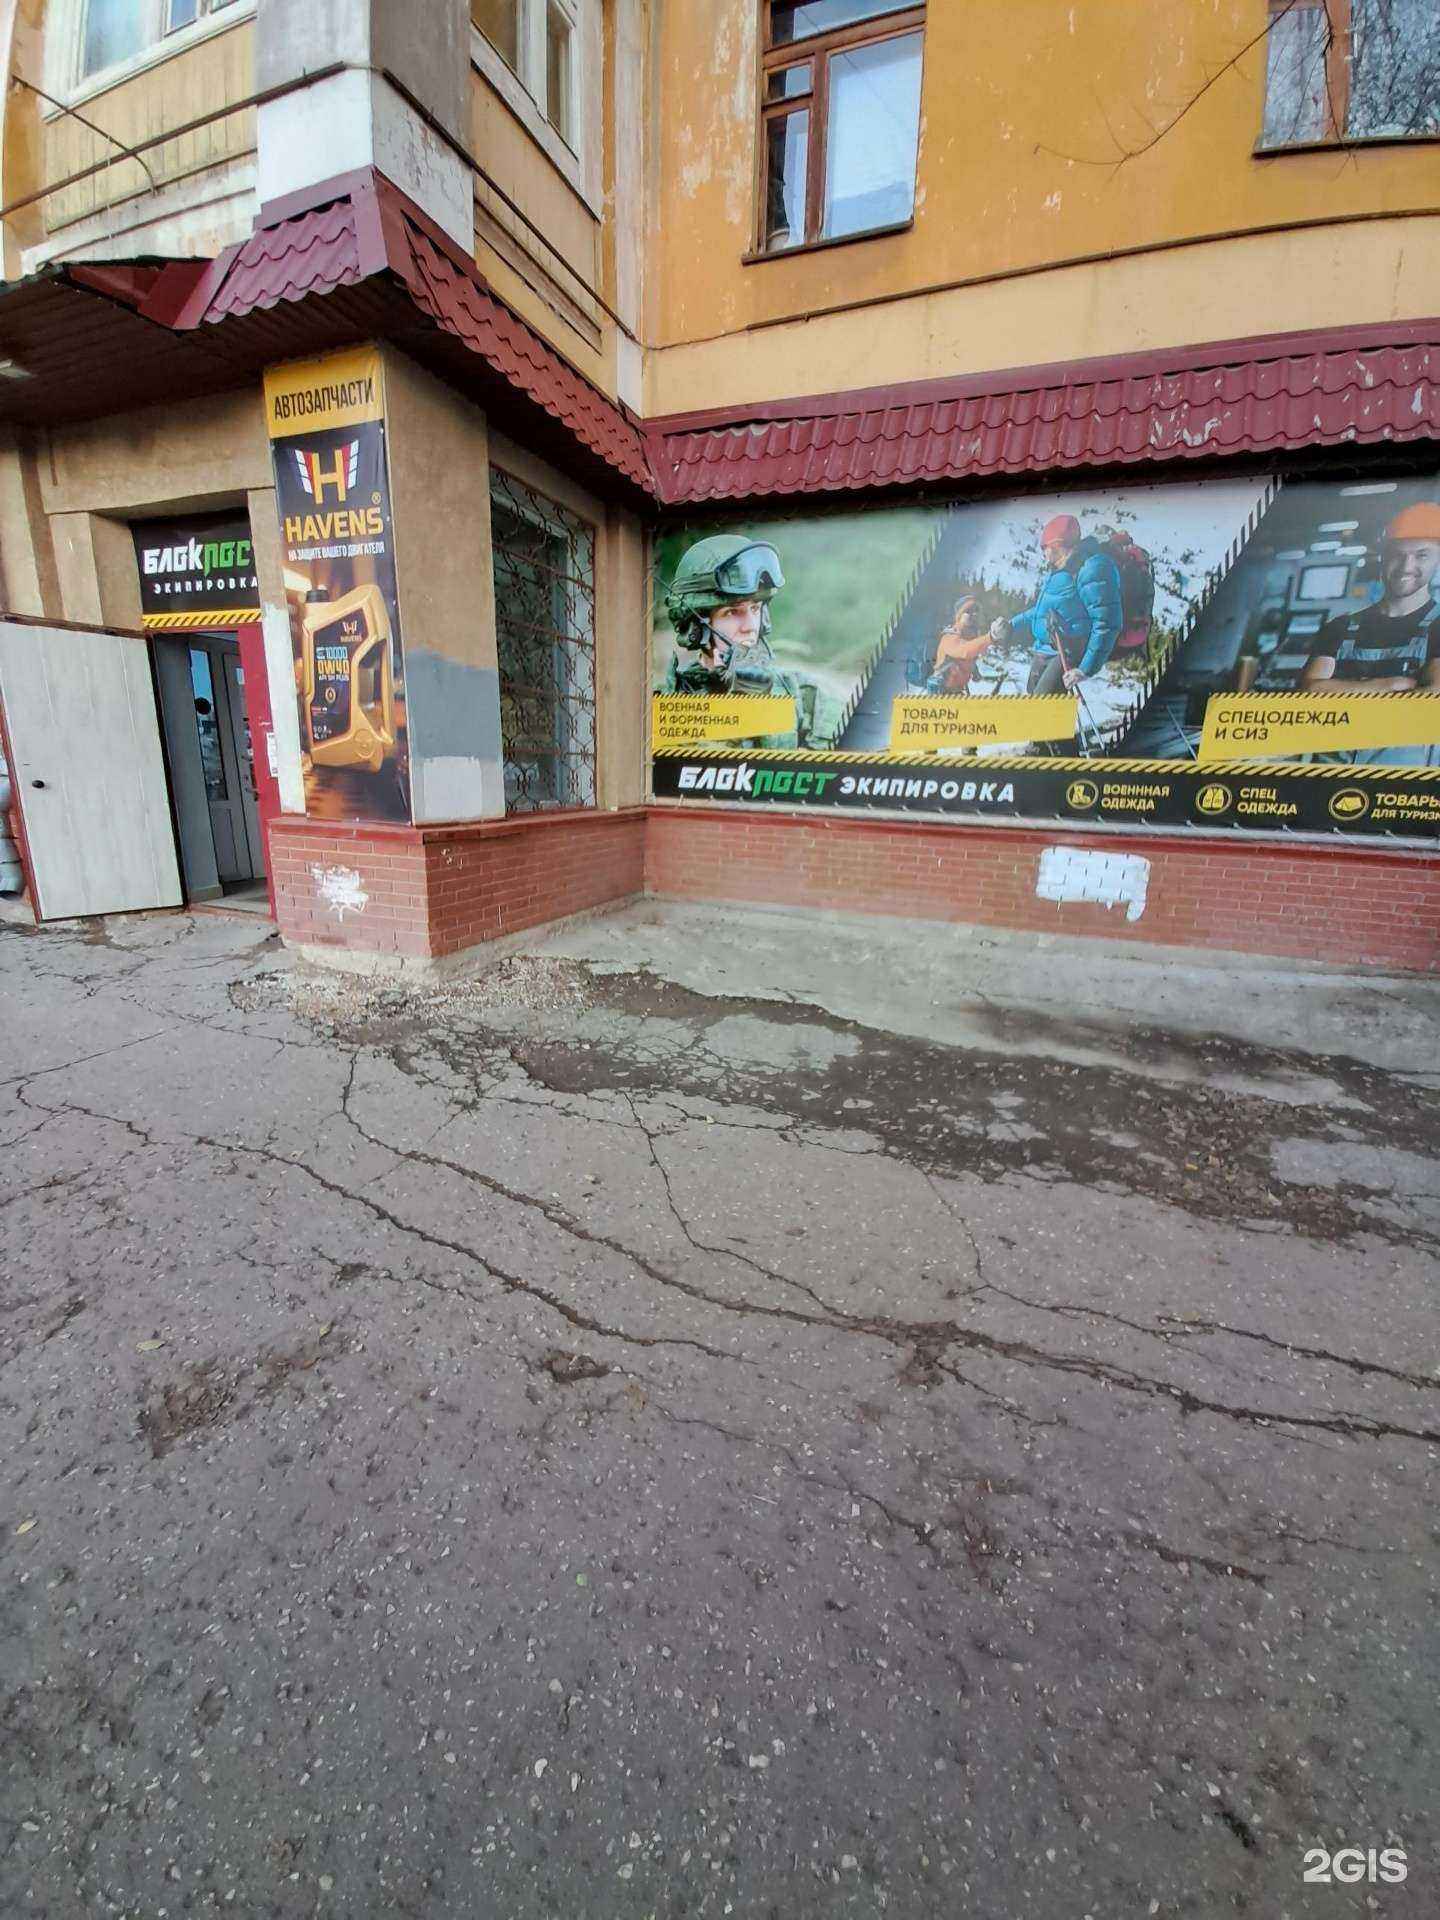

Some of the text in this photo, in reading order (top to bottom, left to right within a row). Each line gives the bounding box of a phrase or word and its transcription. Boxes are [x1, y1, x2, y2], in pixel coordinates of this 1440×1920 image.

[274, 378, 373, 420] АВТОЗАПЧАСТИ
[285, 507, 384, 543] HAVENS
[143, 537, 251, 576] БЛОКПОС
[154, 577, 258, 594] ЭКИПИРОВКА
[659, 702, 711, 712] ВОЕННАЯ
[902, 708, 960, 720] ТОВАРЫ
[659, 714, 740, 725] И ФОРМЕННАЯ
[1217, 710, 1350, 725] СПЕЦОДЕЖДА
[659, 727, 706, 738] ОДЕЖДА
[900, 722, 998, 735] ДЛЯ ТУРИЗМА
[1215, 728, 1269, 741] И СИЗ
[840, 776, 1015, 803] ЭКИПИРОВКА
[1239, 787, 1277, 801] СПЕЦ
[1101, 797, 1155, 811] ОДЕЖДА
[1237, 801, 1298, 815] ОДЕЖДА
[1371, 808, 1397, 819] ДЛЯ
